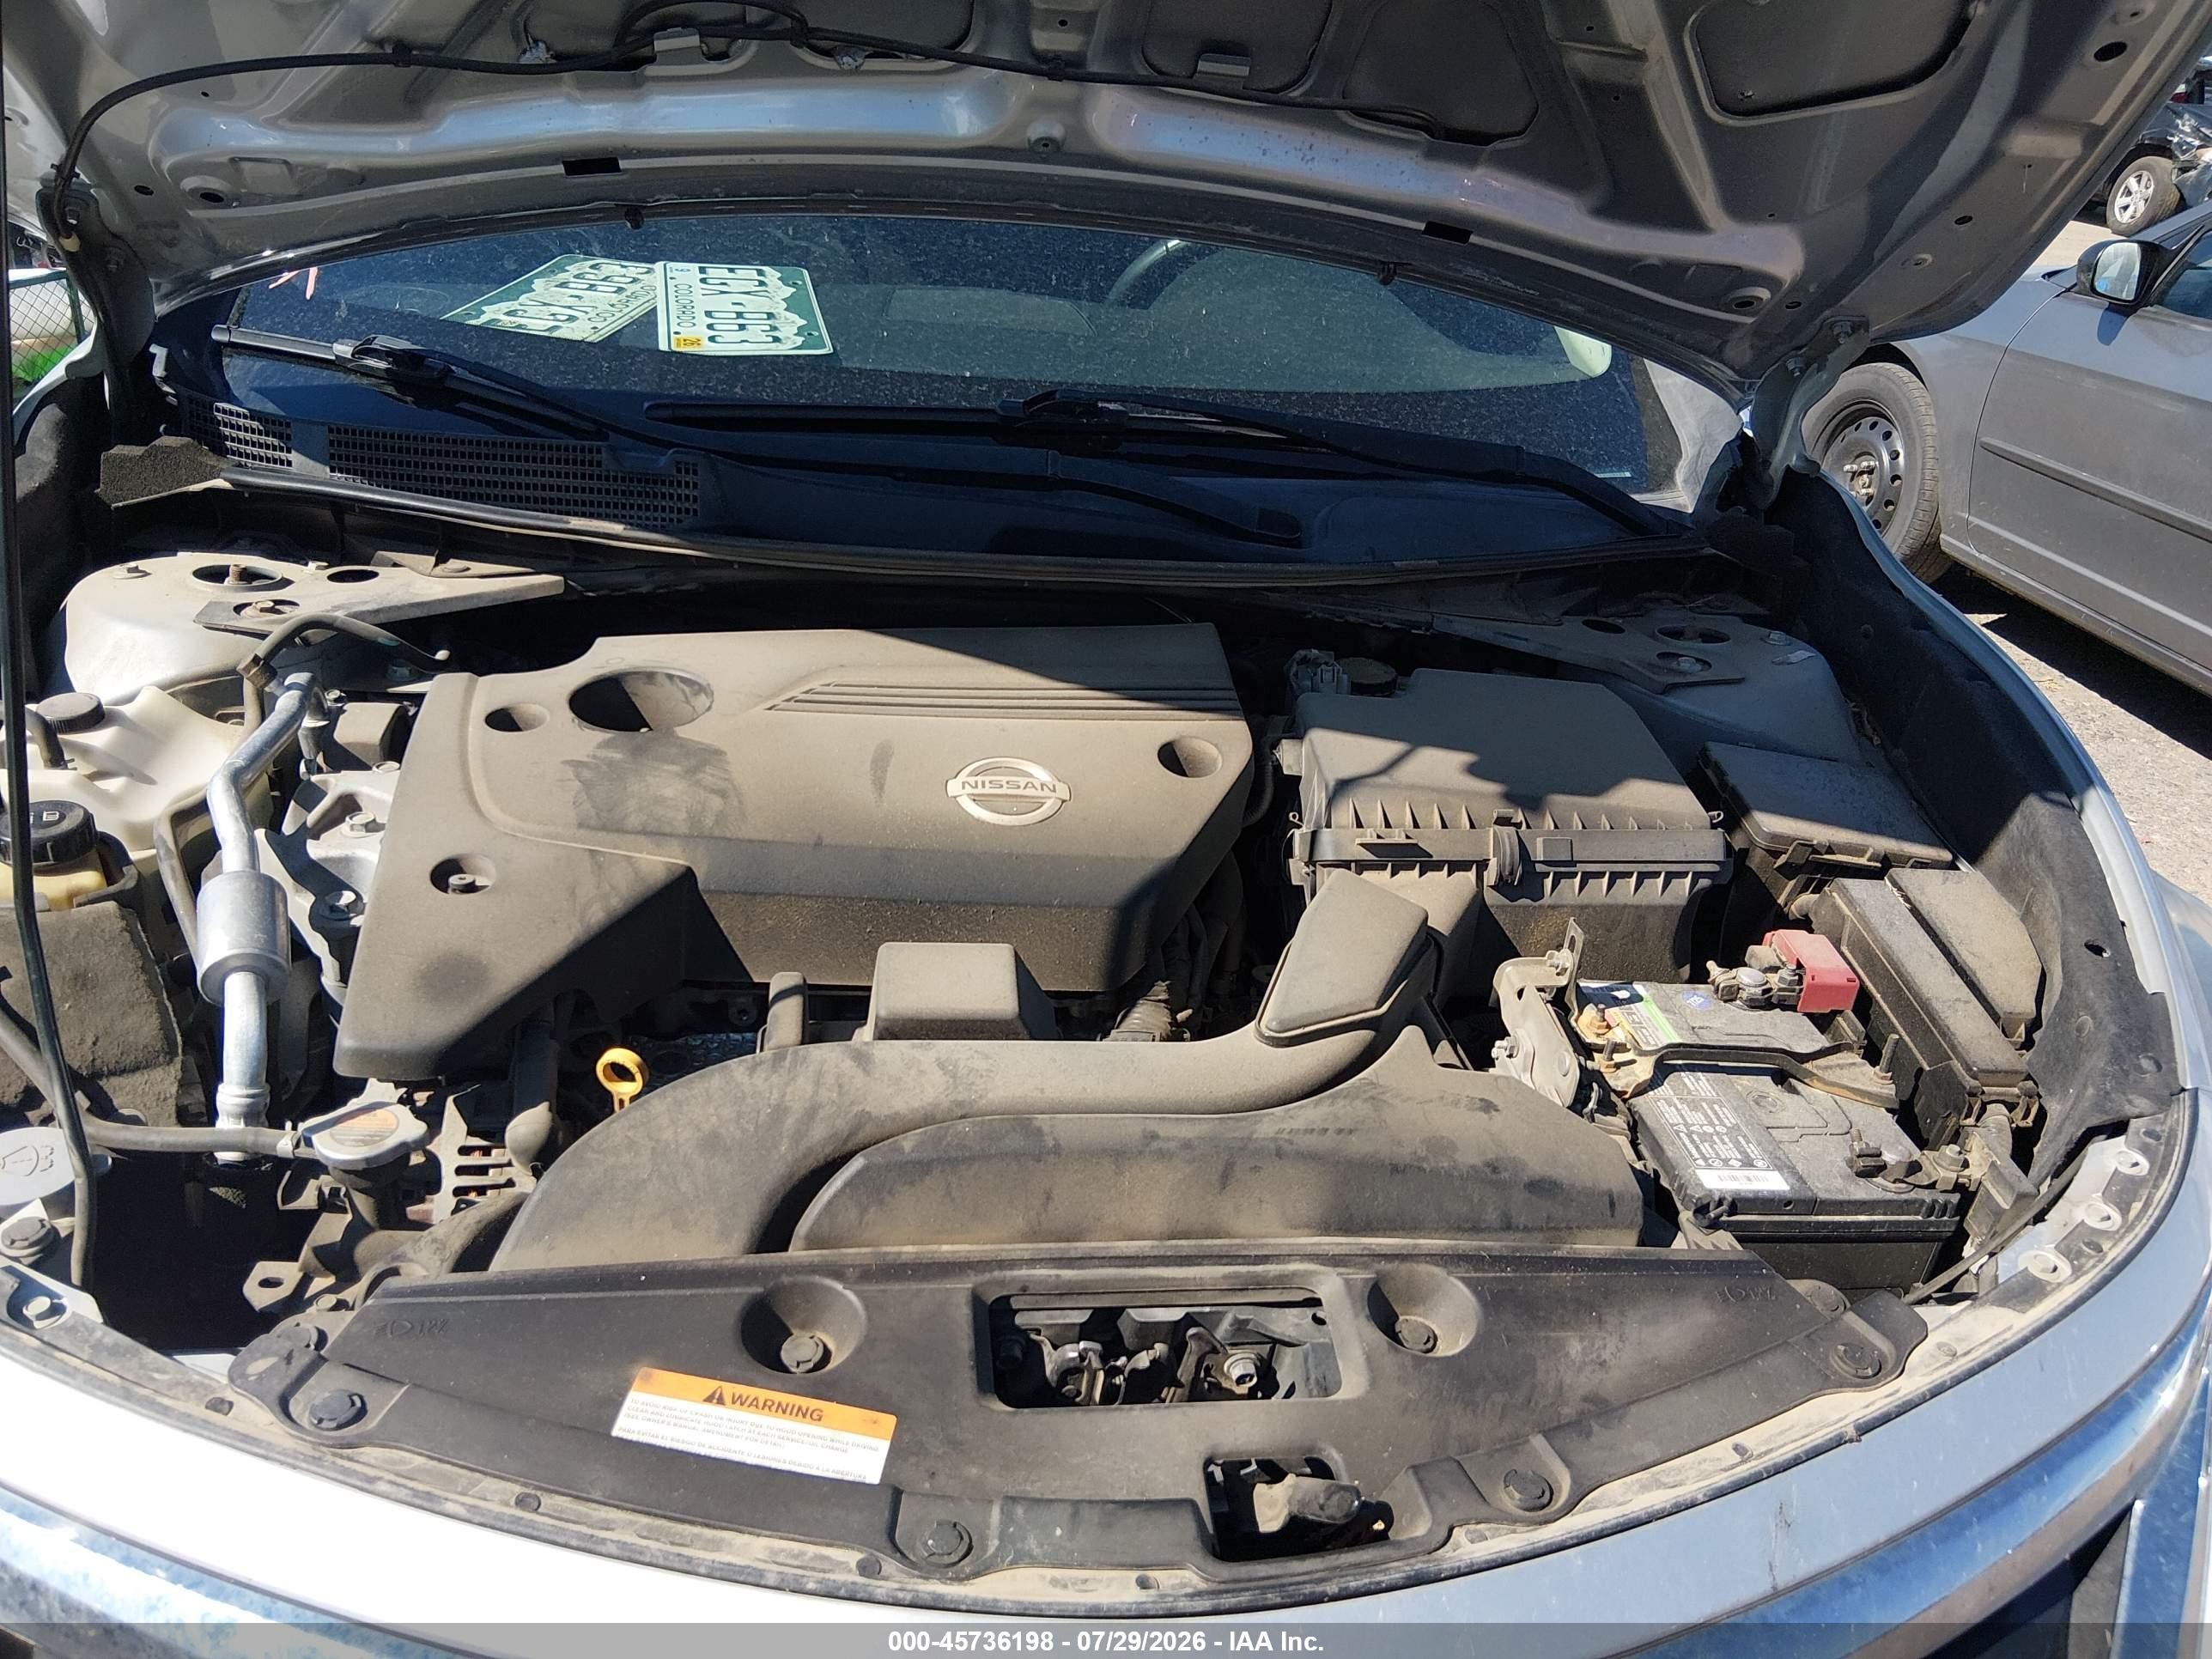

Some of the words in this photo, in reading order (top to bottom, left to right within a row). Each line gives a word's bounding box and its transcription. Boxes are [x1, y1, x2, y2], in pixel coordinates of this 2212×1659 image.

[674, 283, 696, 328] COLORADO
[962, 780, 1057, 793] NISSAN
[730, 1391, 824, 1422] WARNING
